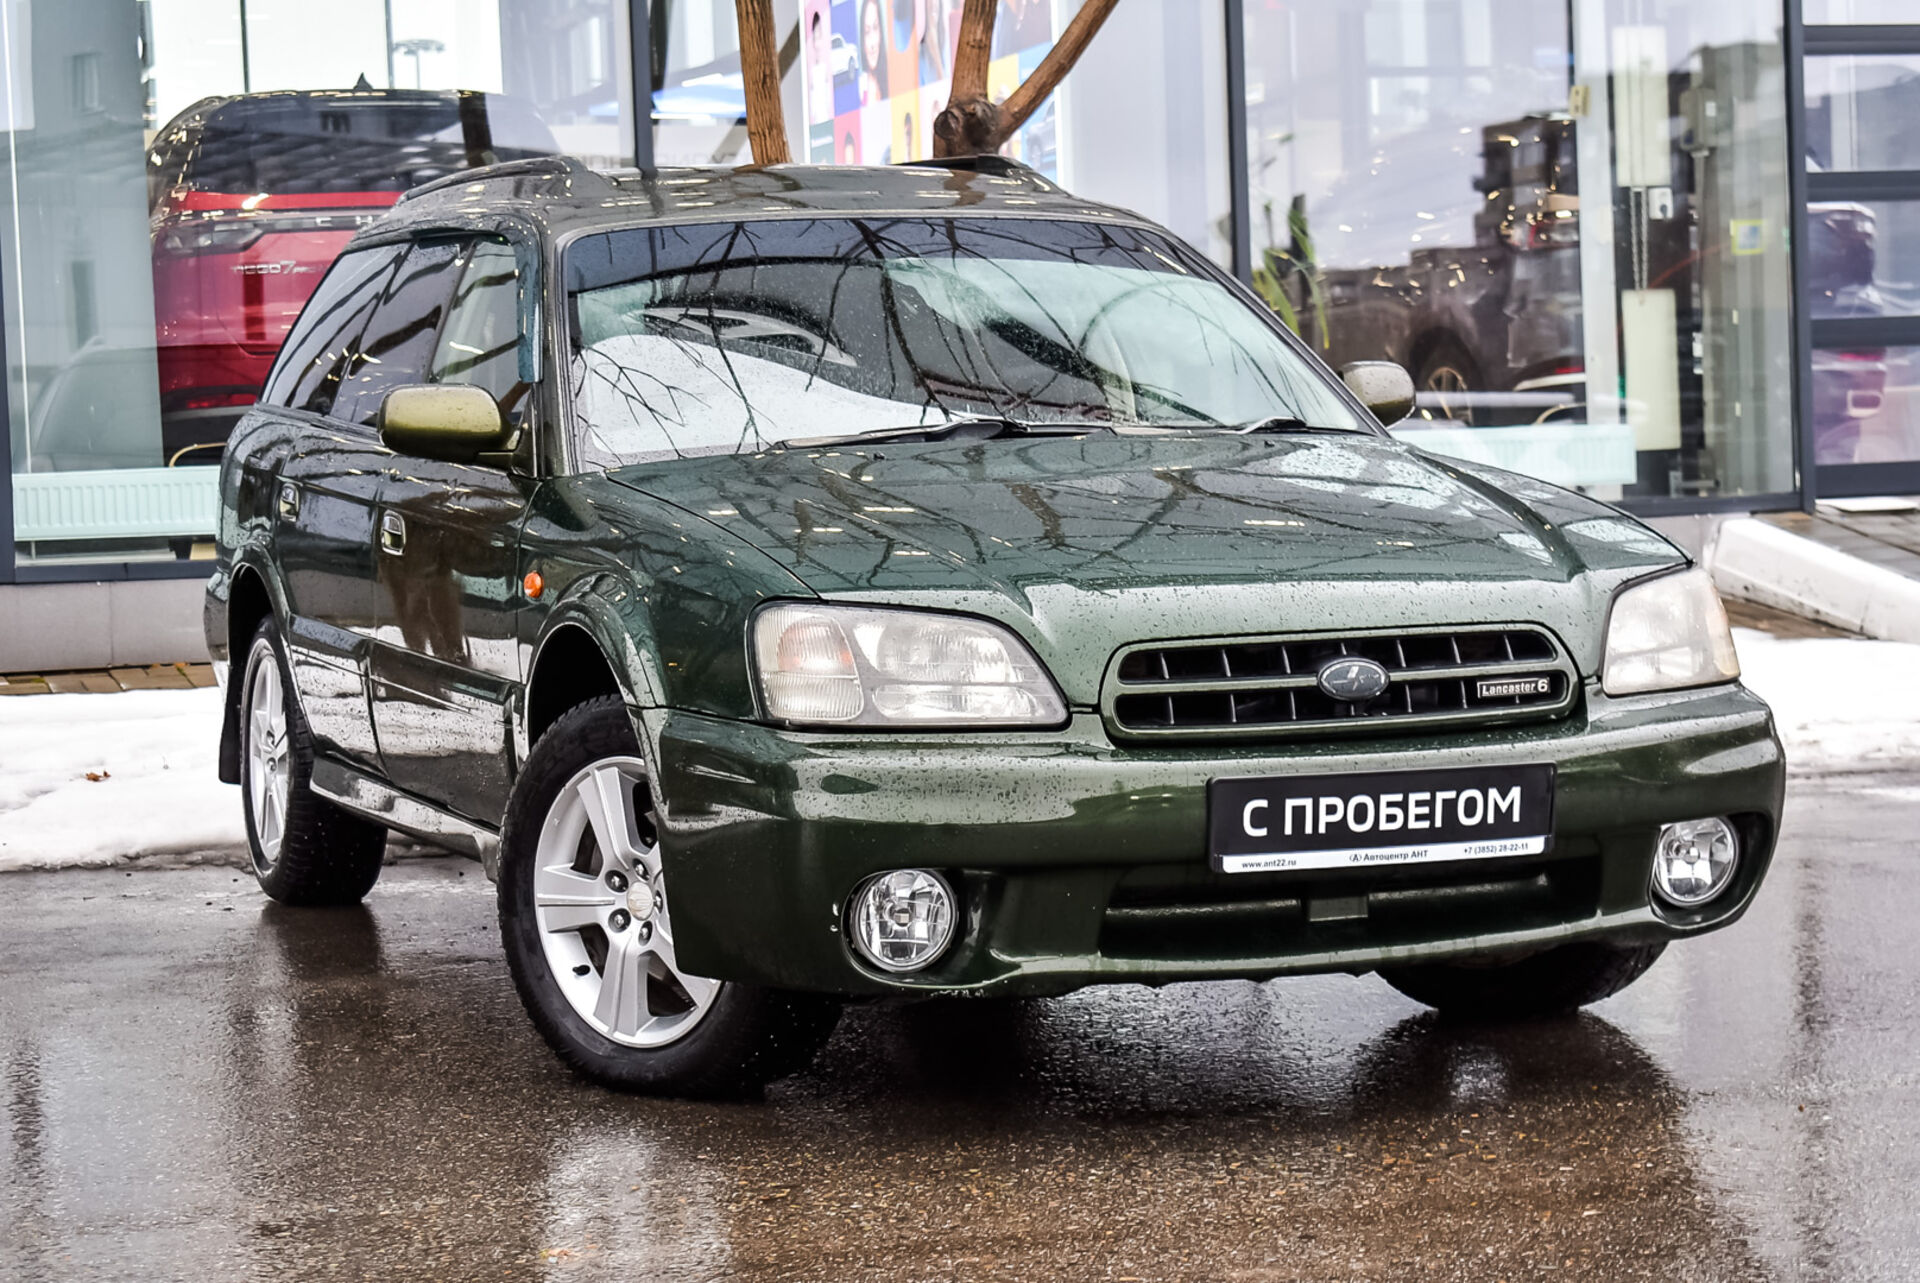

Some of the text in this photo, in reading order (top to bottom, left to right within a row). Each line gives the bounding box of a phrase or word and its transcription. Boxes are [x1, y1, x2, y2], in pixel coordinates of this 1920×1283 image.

[1482, 682, 1537, 696] Lancaster
[1242, 786, 1522, 837] С ПРОБЕГОМ
[1363, 852, 1409, 861] Автоцентр
[1411, 849, 1428, 858] АНТ
[1242, 858, 1297, 868] www.ant22.ru
